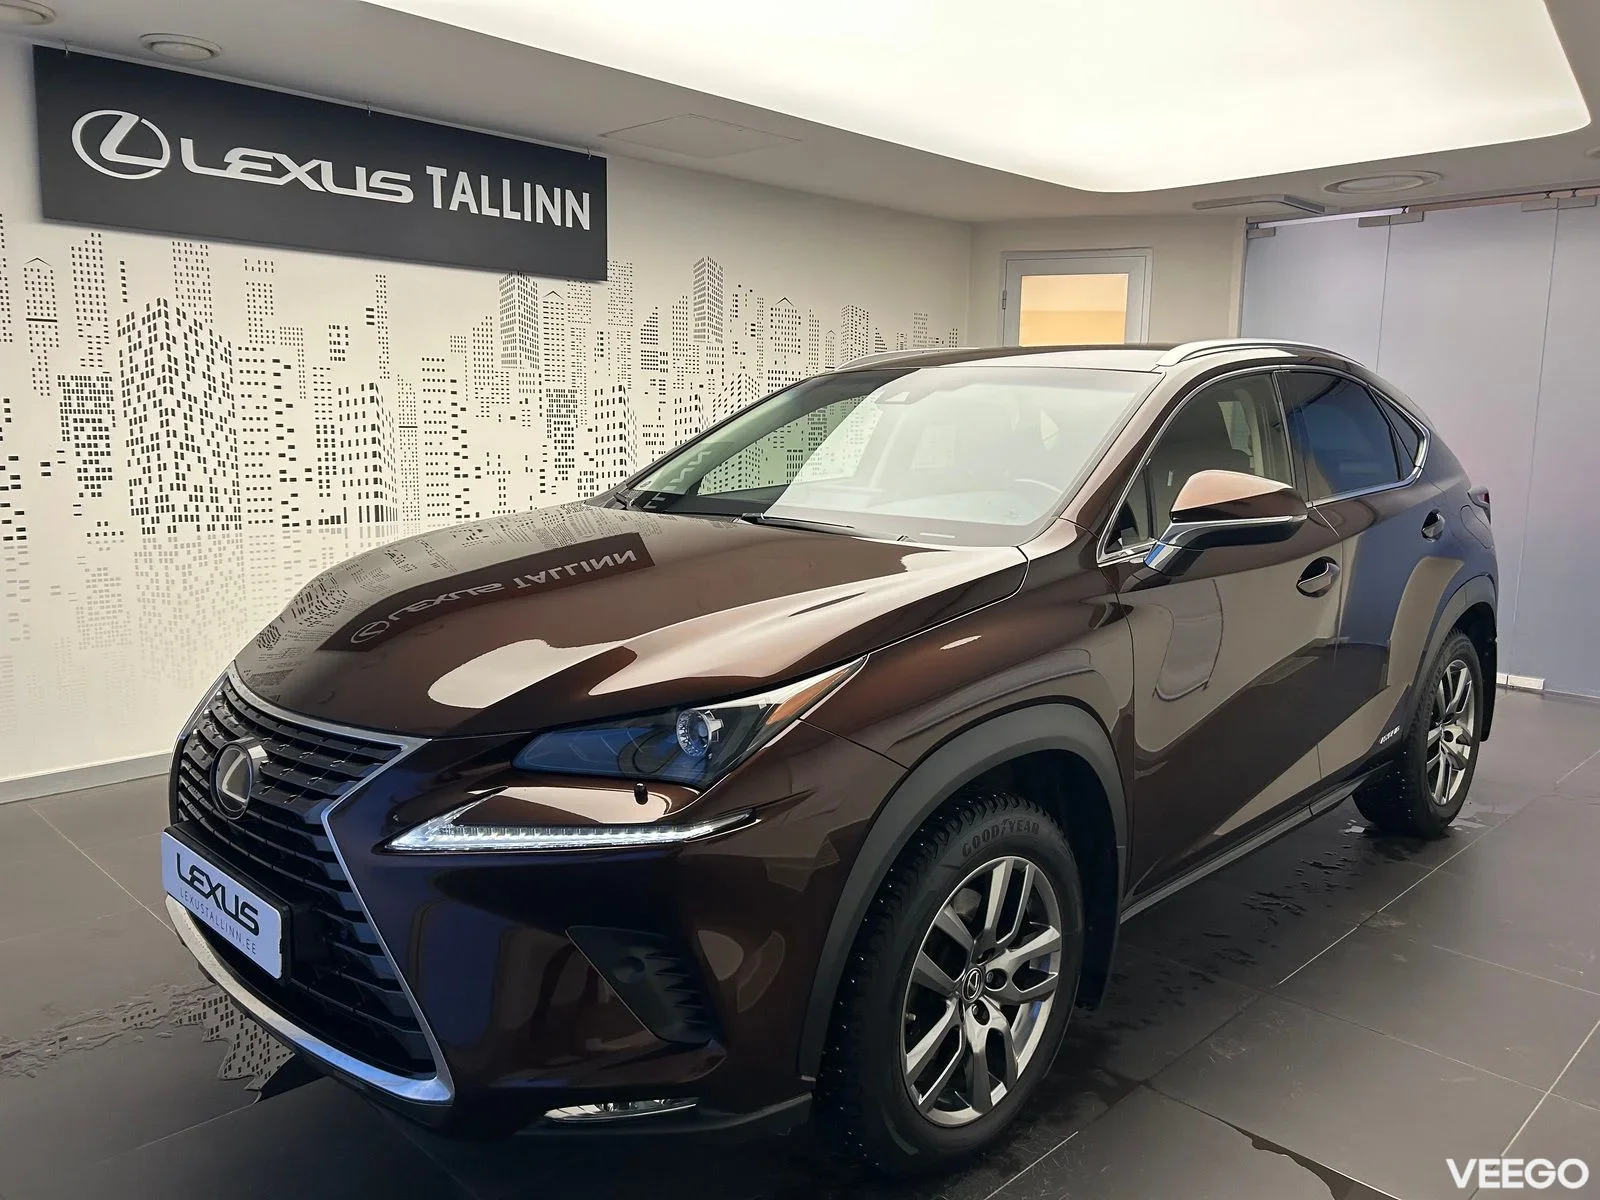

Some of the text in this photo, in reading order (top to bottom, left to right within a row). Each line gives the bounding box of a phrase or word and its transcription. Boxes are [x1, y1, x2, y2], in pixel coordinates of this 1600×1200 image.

[181, 137, 414, 204] LEXUS
[425, 166, 591, 230] TALLINN
[962, 819, 1040, 857] GOODYEAR
[177, 852, 260, 936] LEXUS
[180, 887, 257, 955] LEXUSTALLINN.EE
